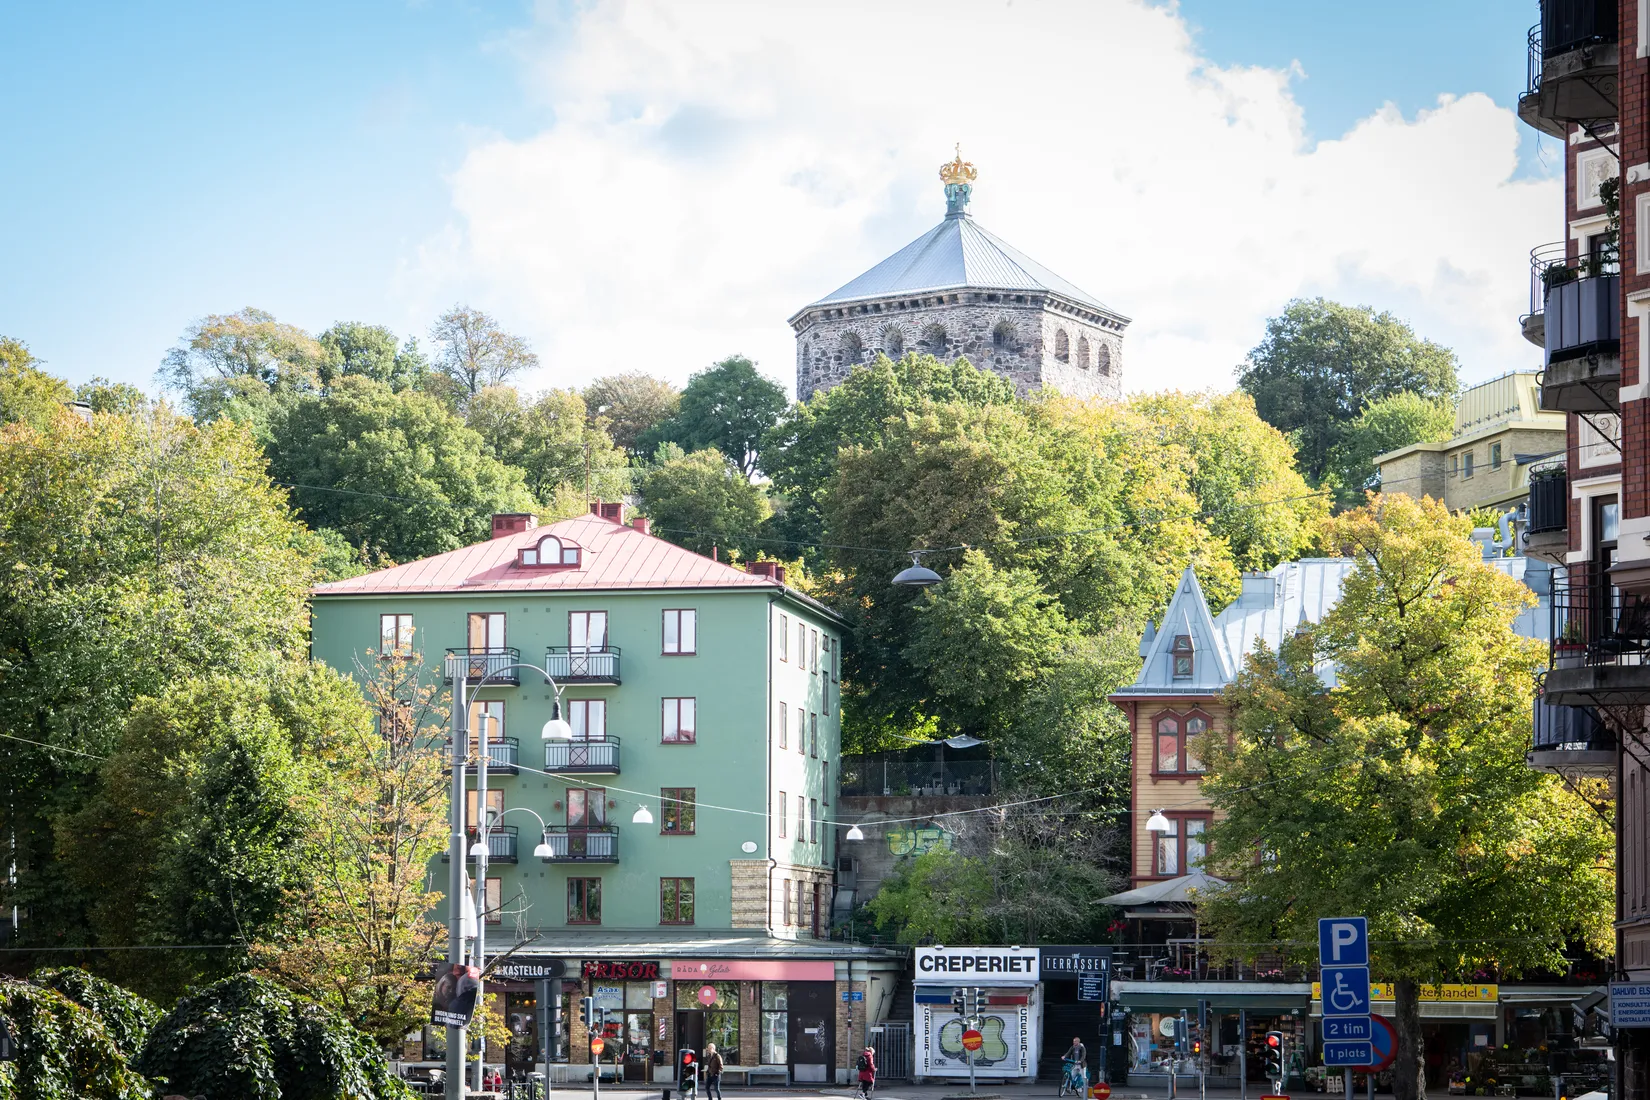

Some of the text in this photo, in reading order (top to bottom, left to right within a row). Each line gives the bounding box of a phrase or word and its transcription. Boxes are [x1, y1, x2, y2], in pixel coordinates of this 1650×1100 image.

[1332, 923, 1358, 960] P
[584, 961, 657, 978] FRISÖR
[920, 955, 1035, 972] CREPERIET
[1046, 958, 1106, 970] TERRASSEN
[503, 965, 543, 976] KASTELLO
[677, 964, 730, 978] RÅDA Gelato
[1613, 988, 1636, 996] DAHLVID
[1330, 1023, 1364, 1034] 2 tim
[1020, 1008, 1028, 1072] CREPERIET
[1338, 1049, 1366, 1060] plats
